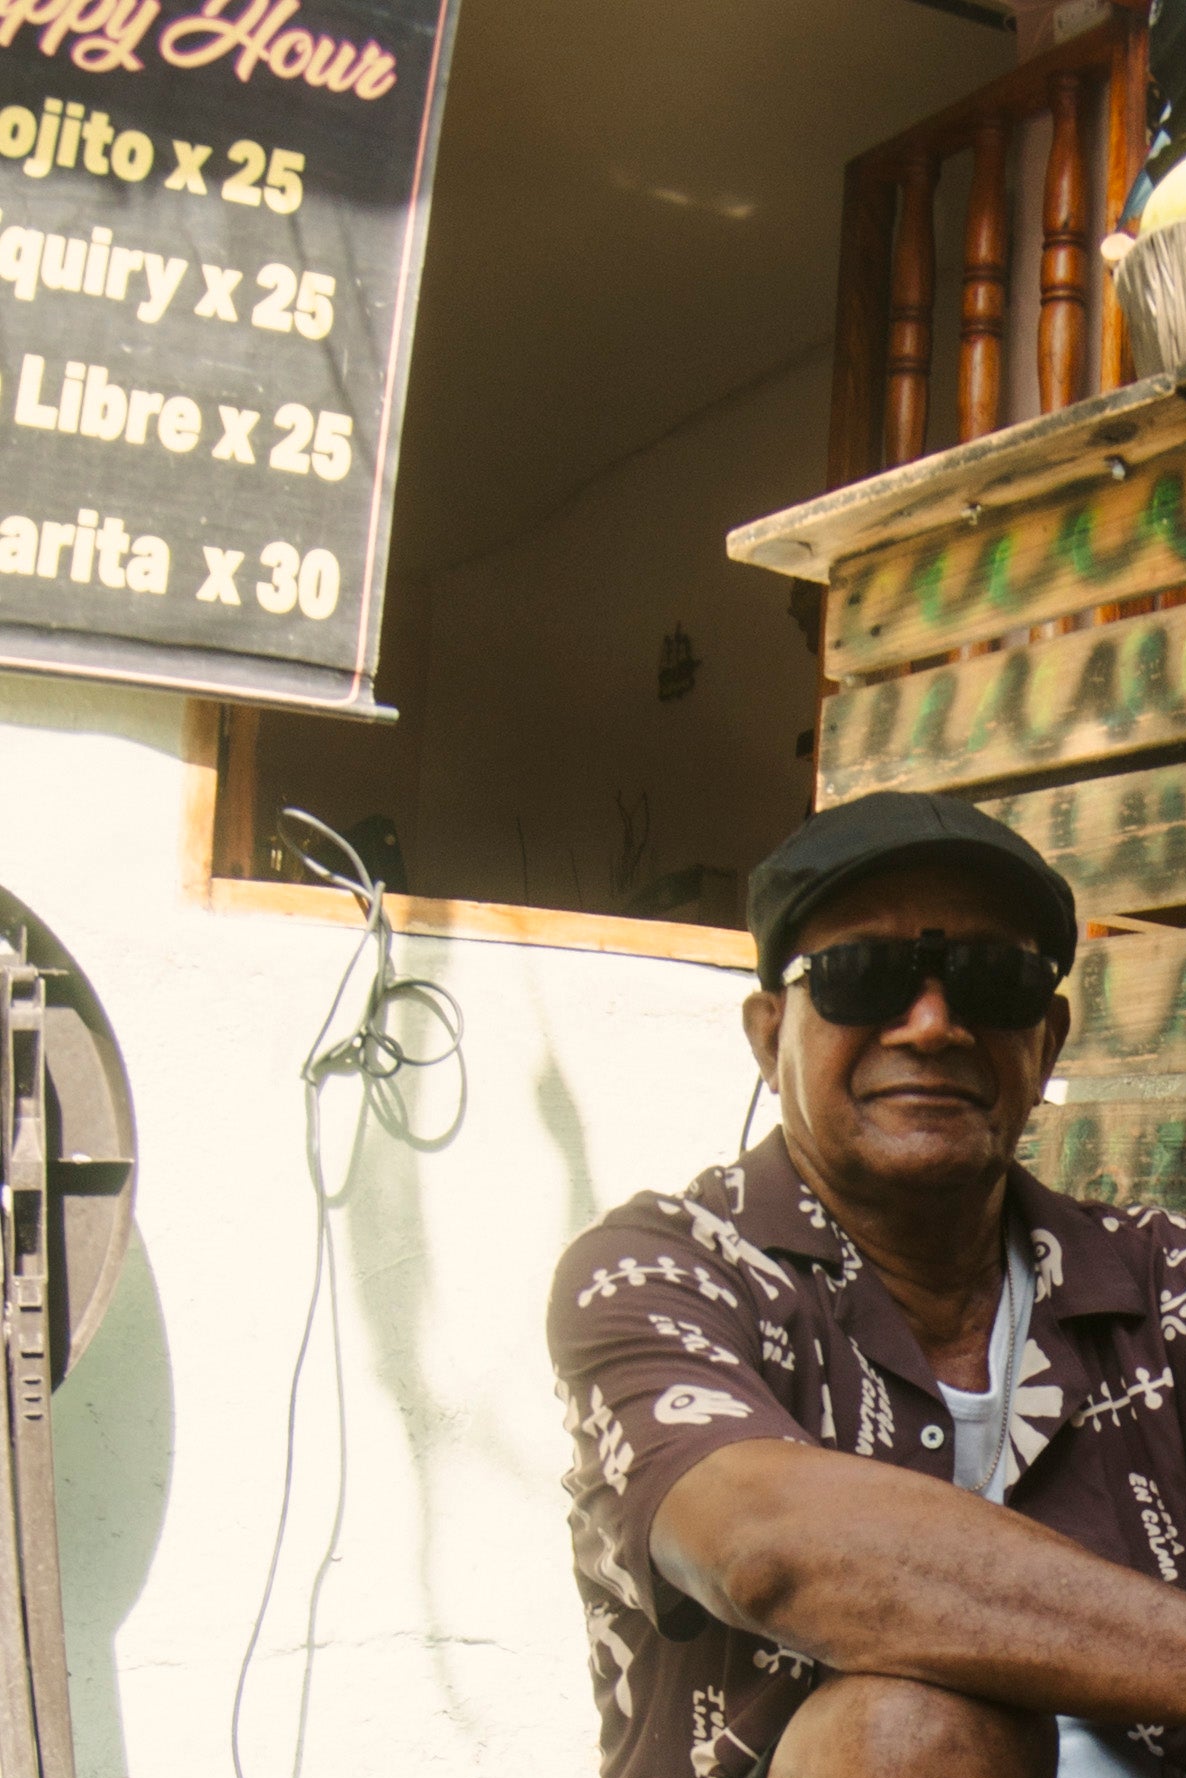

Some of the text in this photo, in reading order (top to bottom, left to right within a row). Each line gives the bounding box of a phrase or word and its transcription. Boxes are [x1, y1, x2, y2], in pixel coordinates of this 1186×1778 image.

[0, 217, 189, 325] quiry
[14, 353, 203, 454] Libre
[1128, 1472, 1179, 1582] EN CALMA
